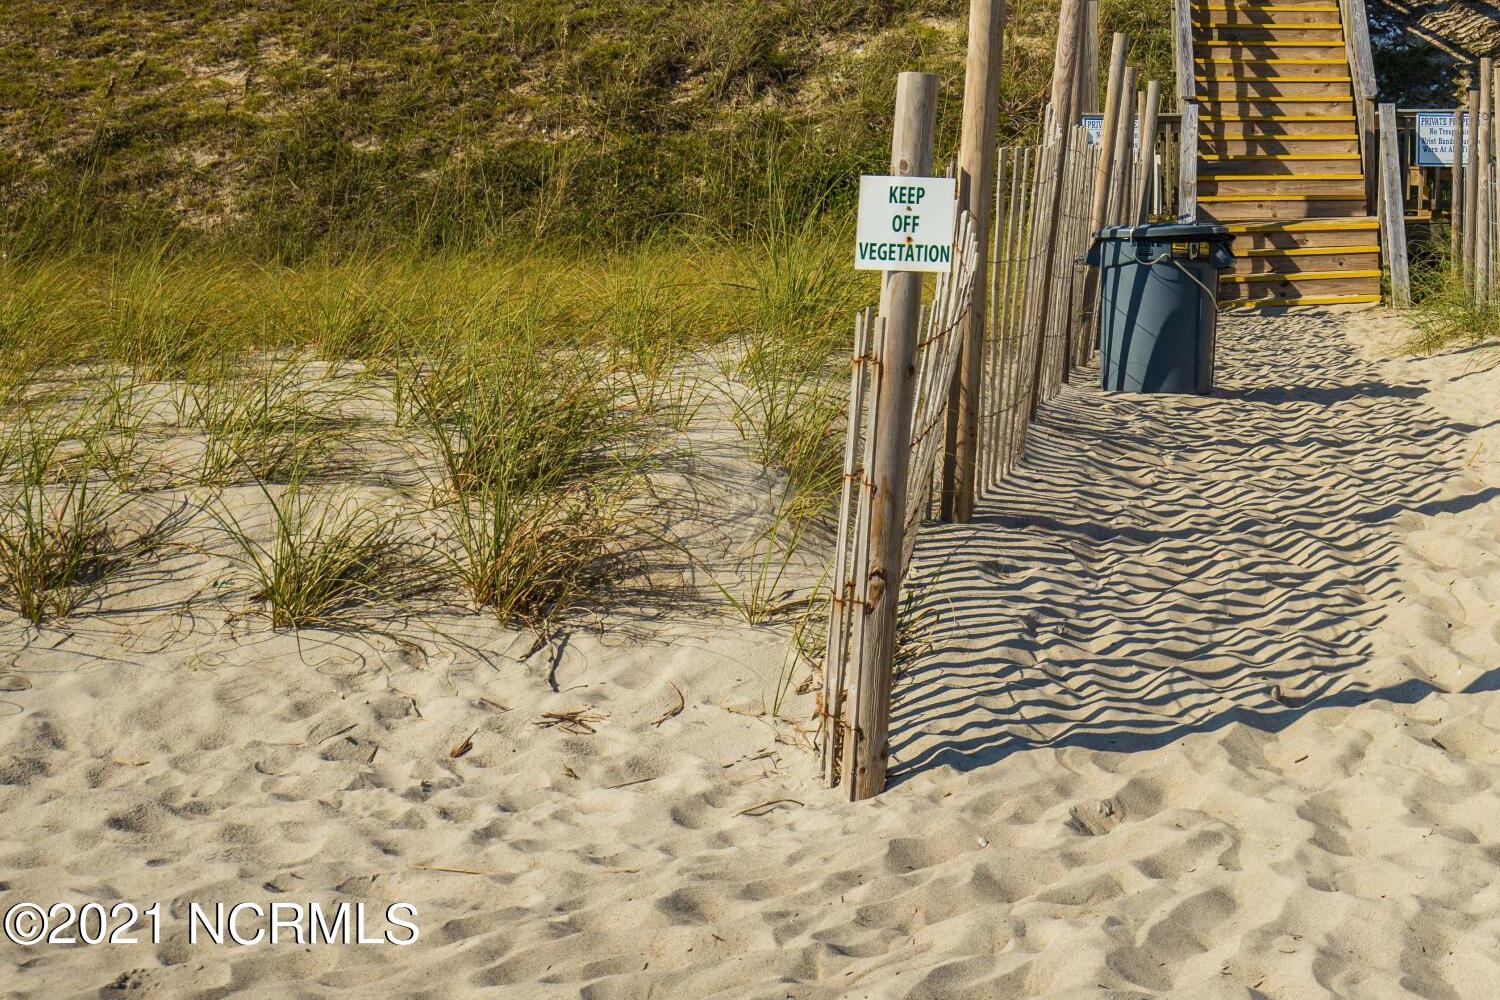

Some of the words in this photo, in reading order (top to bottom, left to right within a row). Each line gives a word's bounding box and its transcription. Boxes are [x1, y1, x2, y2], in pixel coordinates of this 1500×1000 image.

[889, 186, 925, 205] KEEP
[892, 214, 920, 233] OFF
[859, 242, 950, 263] VEGETATION
